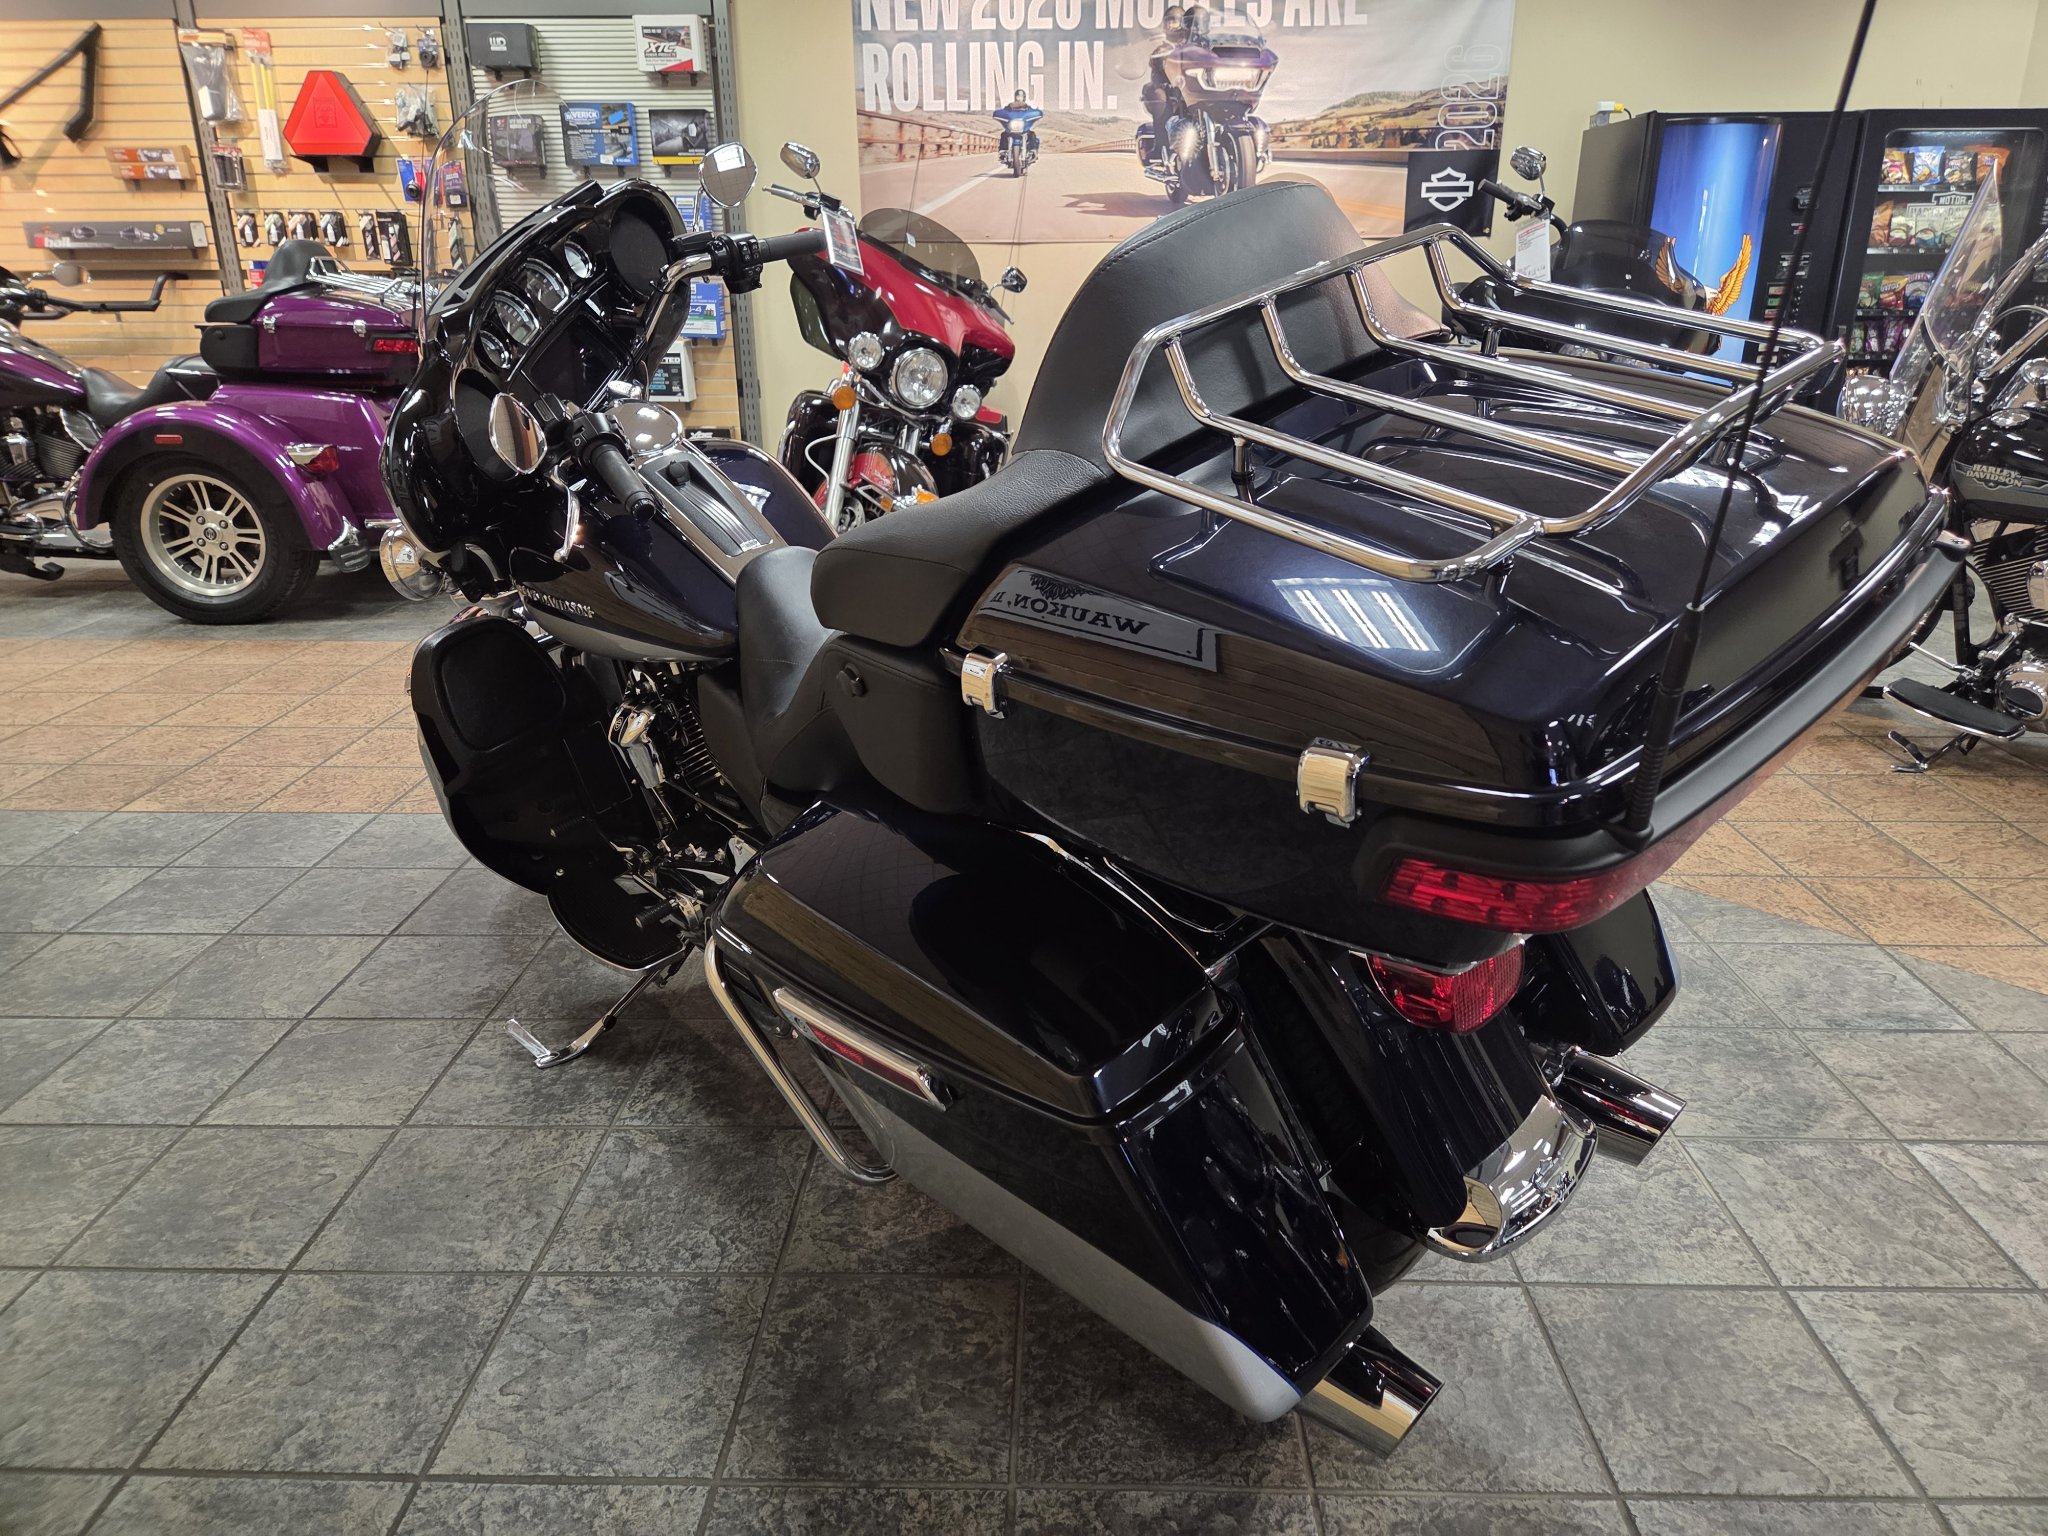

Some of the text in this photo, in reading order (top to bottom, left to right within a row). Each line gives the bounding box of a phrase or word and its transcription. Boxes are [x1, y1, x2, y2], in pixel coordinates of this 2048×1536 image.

[862, 40, 1118, 113] ROLLING IN.
[1435, 44, 1503, 150] 2026
[1966, 470, 2023, 487] DAVIDSON
